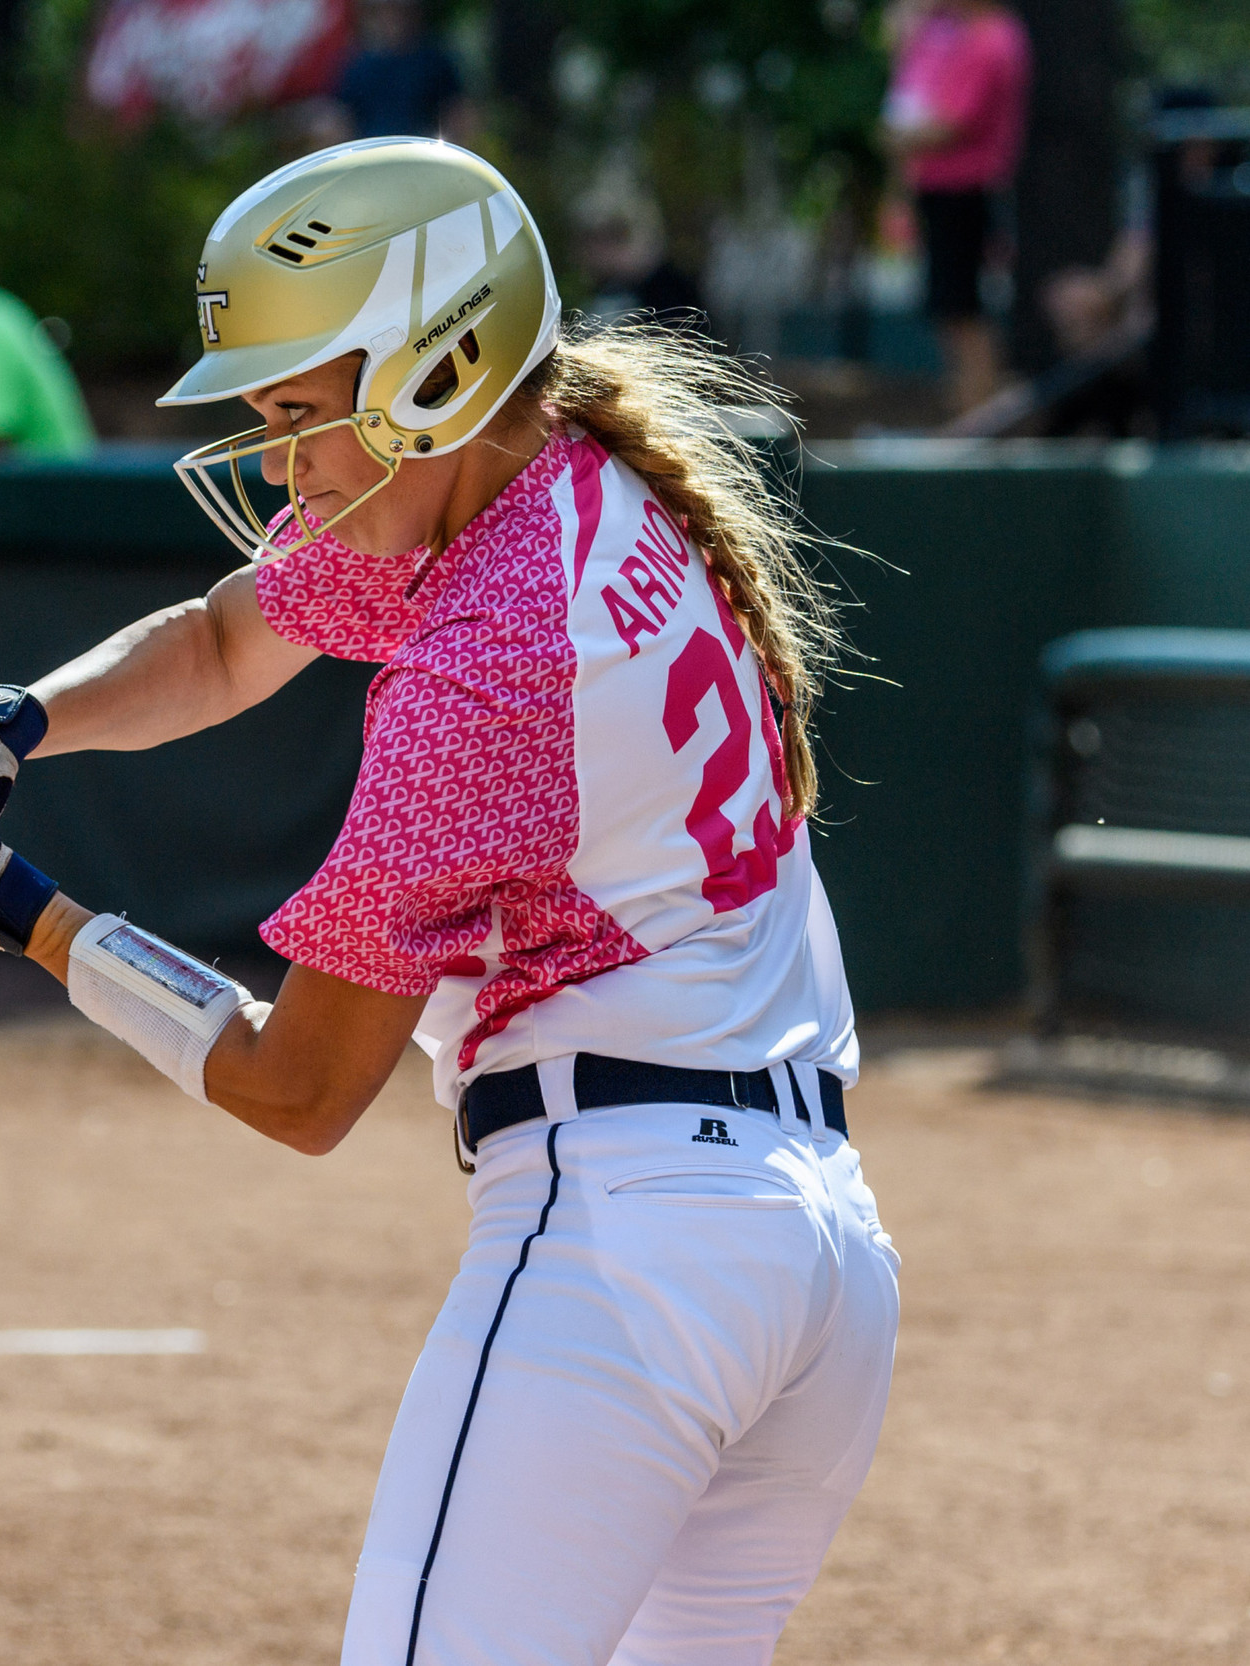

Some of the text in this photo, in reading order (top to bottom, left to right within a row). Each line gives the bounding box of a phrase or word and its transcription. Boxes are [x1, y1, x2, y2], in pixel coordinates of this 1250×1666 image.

[413, 283, 492, 354] RAWLINGS
[700, 1118, 728, 1138] R
[692, 1135, 739, 1147] RUSSELL
